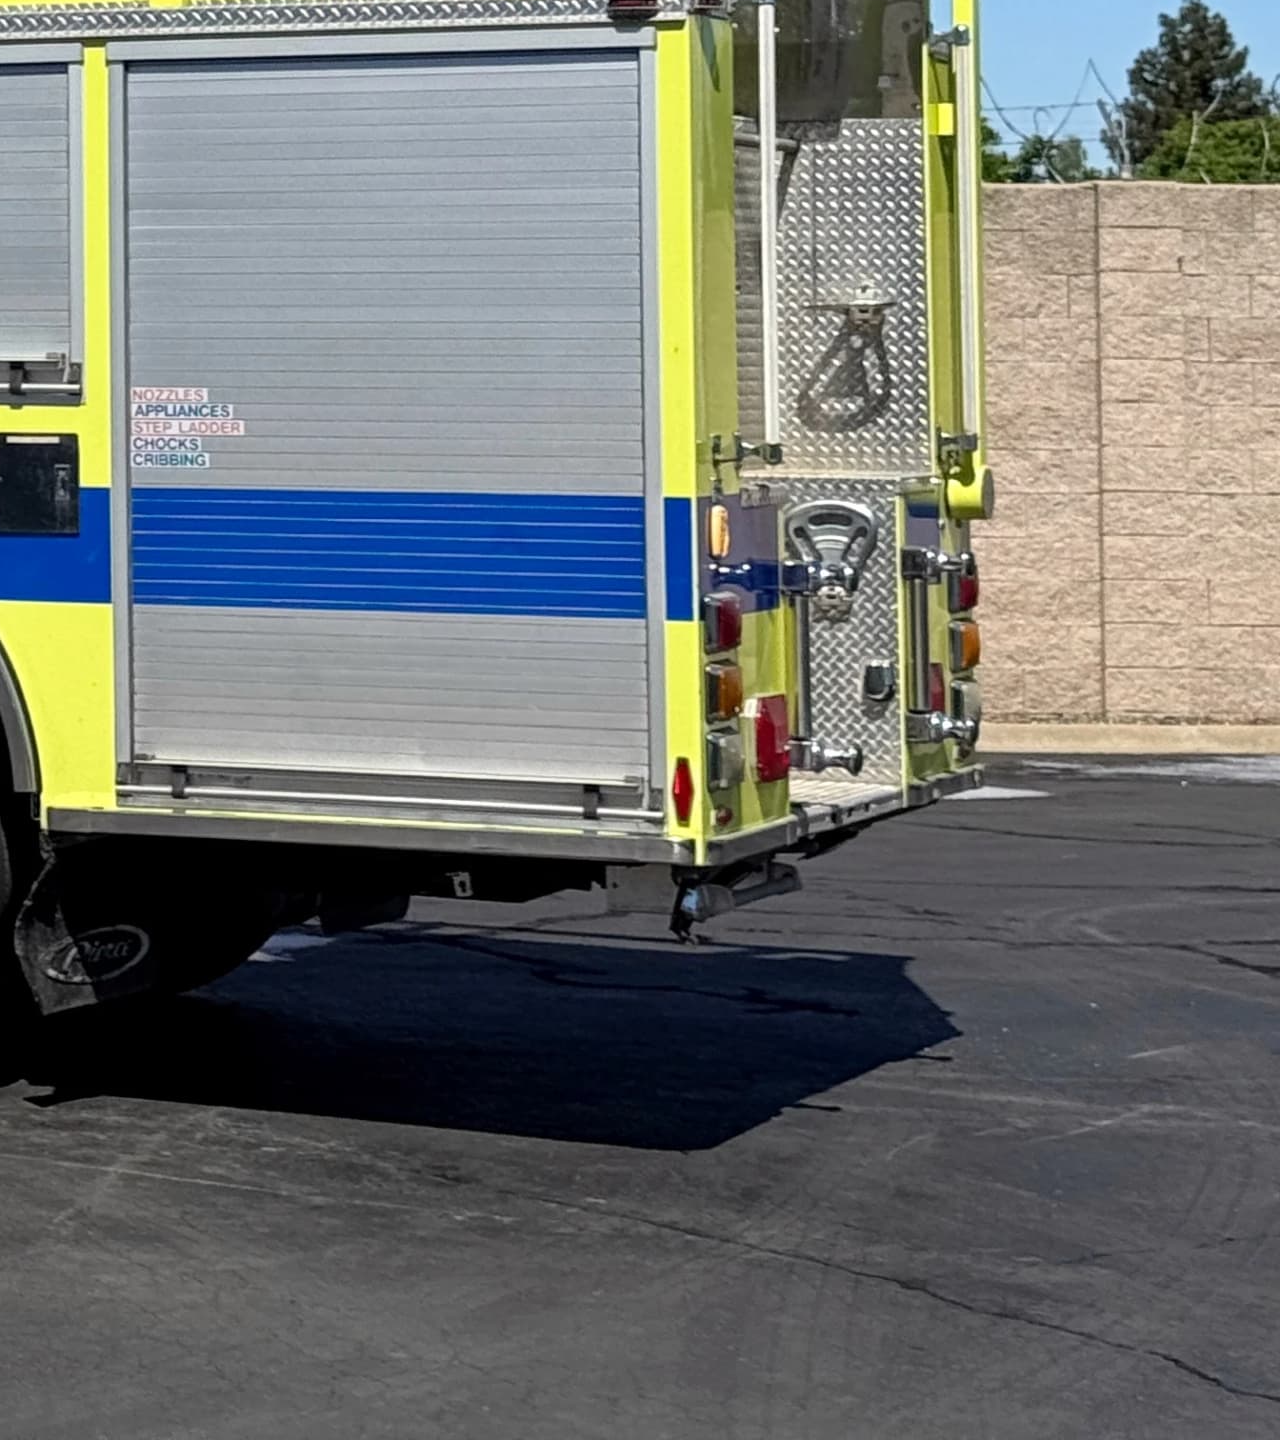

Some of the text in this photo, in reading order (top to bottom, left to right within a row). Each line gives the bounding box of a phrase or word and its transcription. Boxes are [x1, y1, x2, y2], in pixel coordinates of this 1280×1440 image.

[132, 389, 205, 402] NOZZLES
[134, 405, 230, 417] APPLIANCES
[133, 422, 240, 434] STEP LADDER
[133, 438, 199, 450] CHOCKS
[132, 454, 207, 466] CRIBBING
